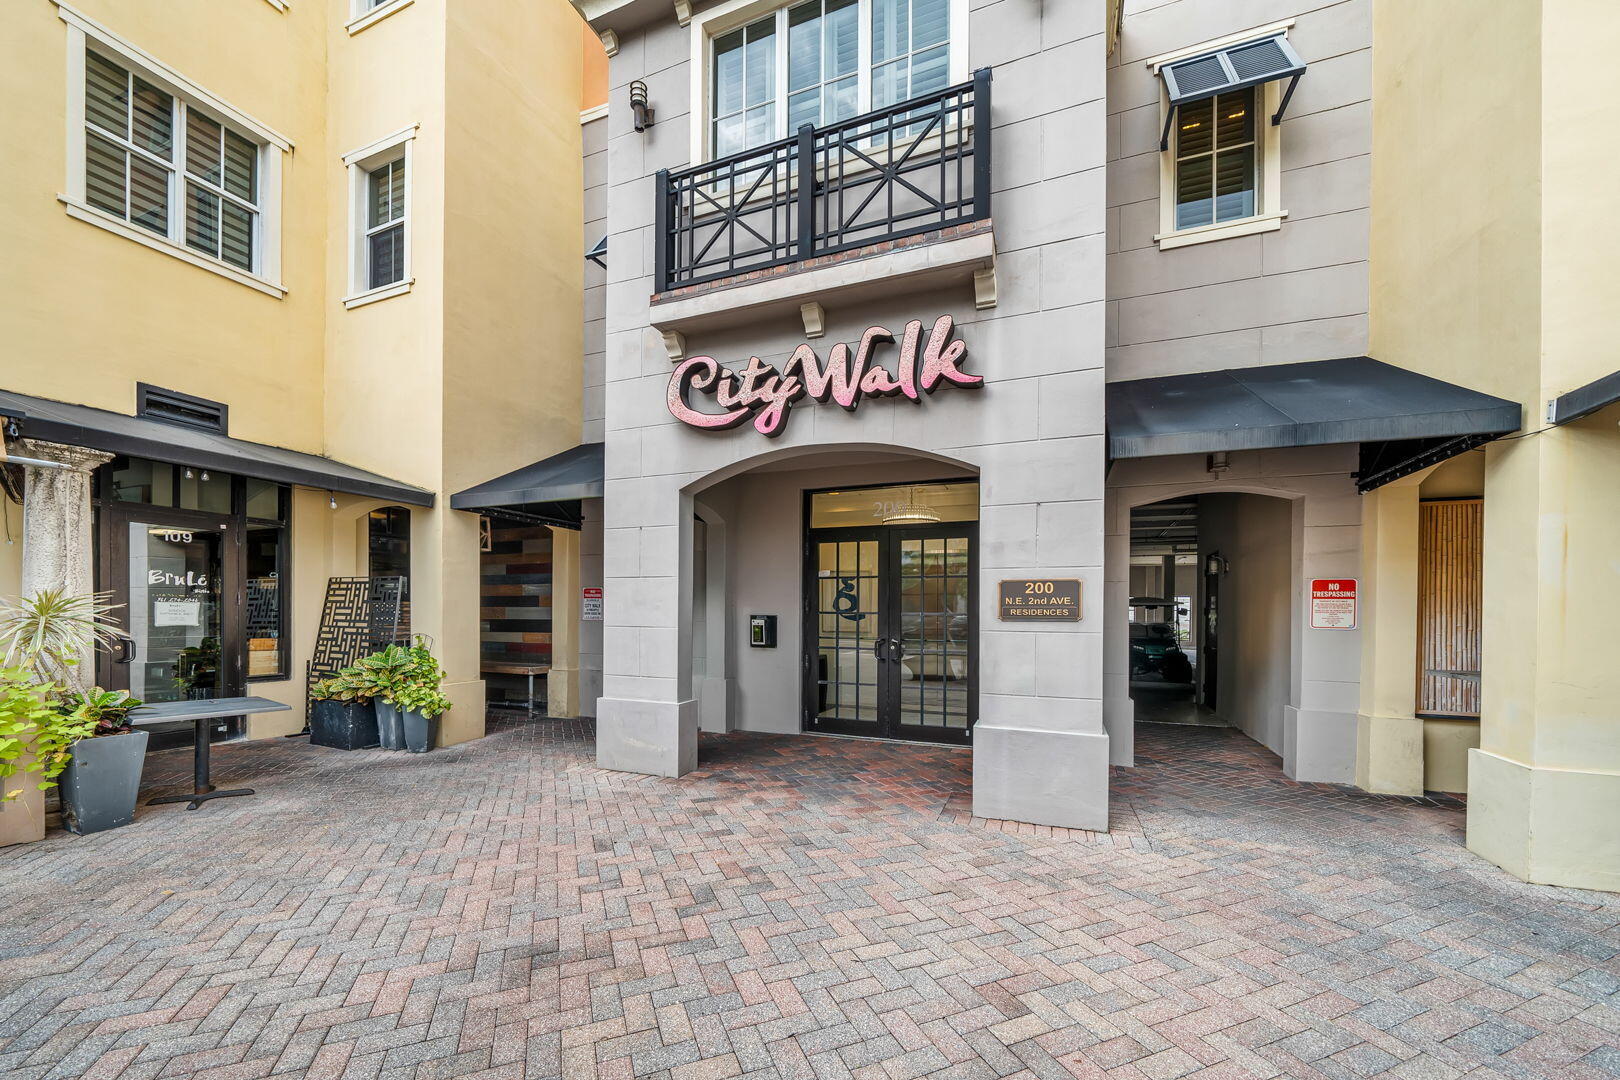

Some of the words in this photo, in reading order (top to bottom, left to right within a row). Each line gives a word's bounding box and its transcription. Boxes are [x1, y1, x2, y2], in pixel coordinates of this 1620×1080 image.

[163, 531, 193, 543] 109
[1025, 582, 1054, 594] 200
[1328, 583, 1340, 591] NO
[1005, 597, 1025, 605] N.E.
[1028, 597, 1047, 605] 2nd
[1049, 597, 1074, 605] AVE.
[1010, 608, 1069, 616] RESIDENCES
